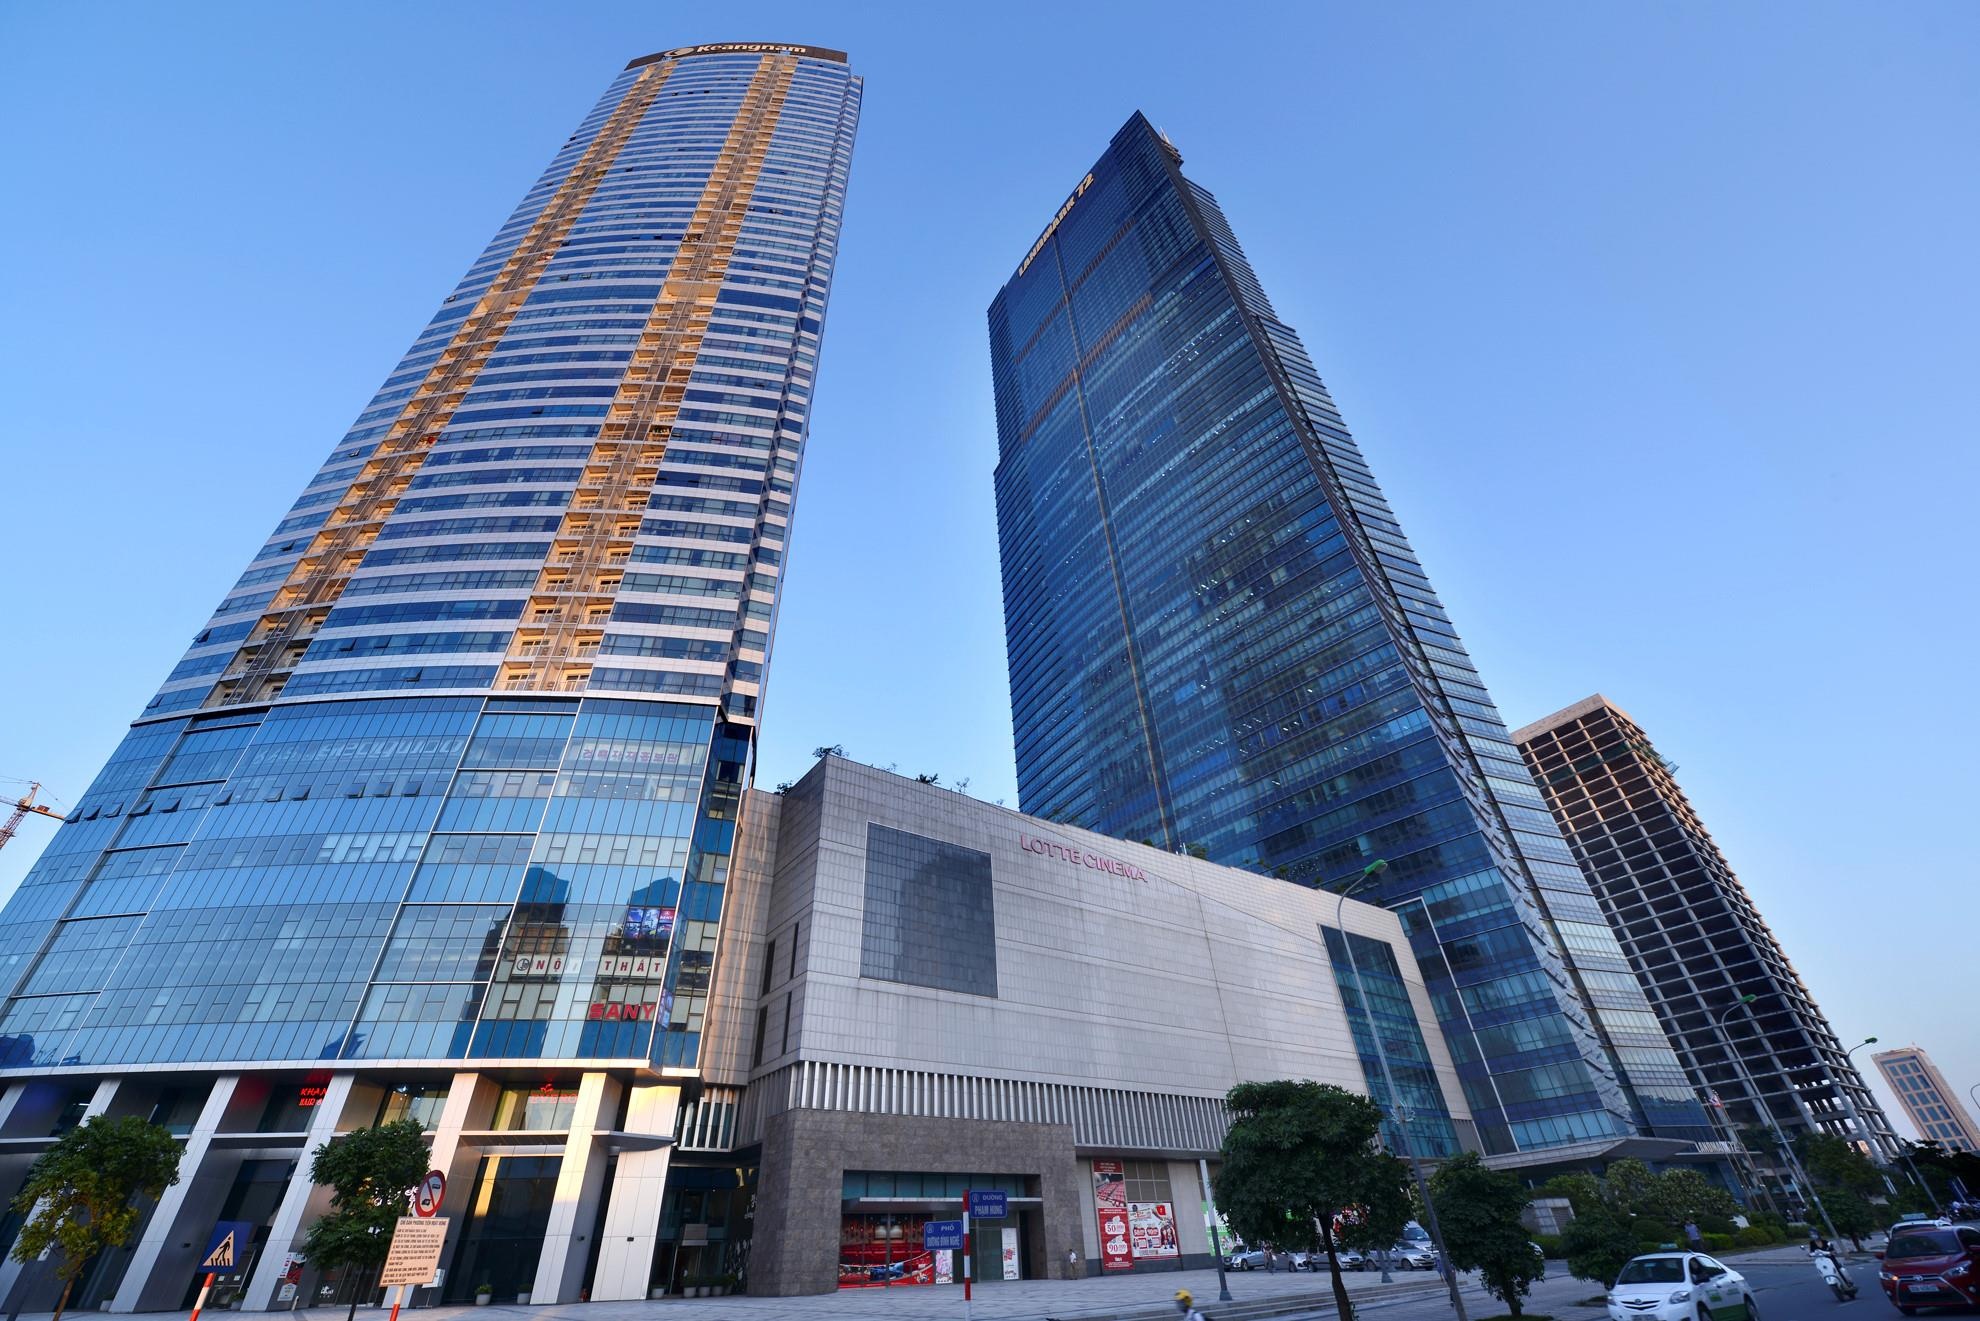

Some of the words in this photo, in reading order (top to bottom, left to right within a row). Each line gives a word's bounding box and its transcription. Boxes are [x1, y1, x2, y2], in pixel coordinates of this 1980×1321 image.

[696, 43, 806, 53] Keangnam
[1018, 195, 1075, 277] LANDMARK
[1075, 173, 1094, 198] 72
[1020, 831, 1081, 865] LOTTE
[1082, 853, 1148, 882] CINEMA
[603, 958, 662, 972] THẤT
[588, 1003, 656, 1020] SANY
